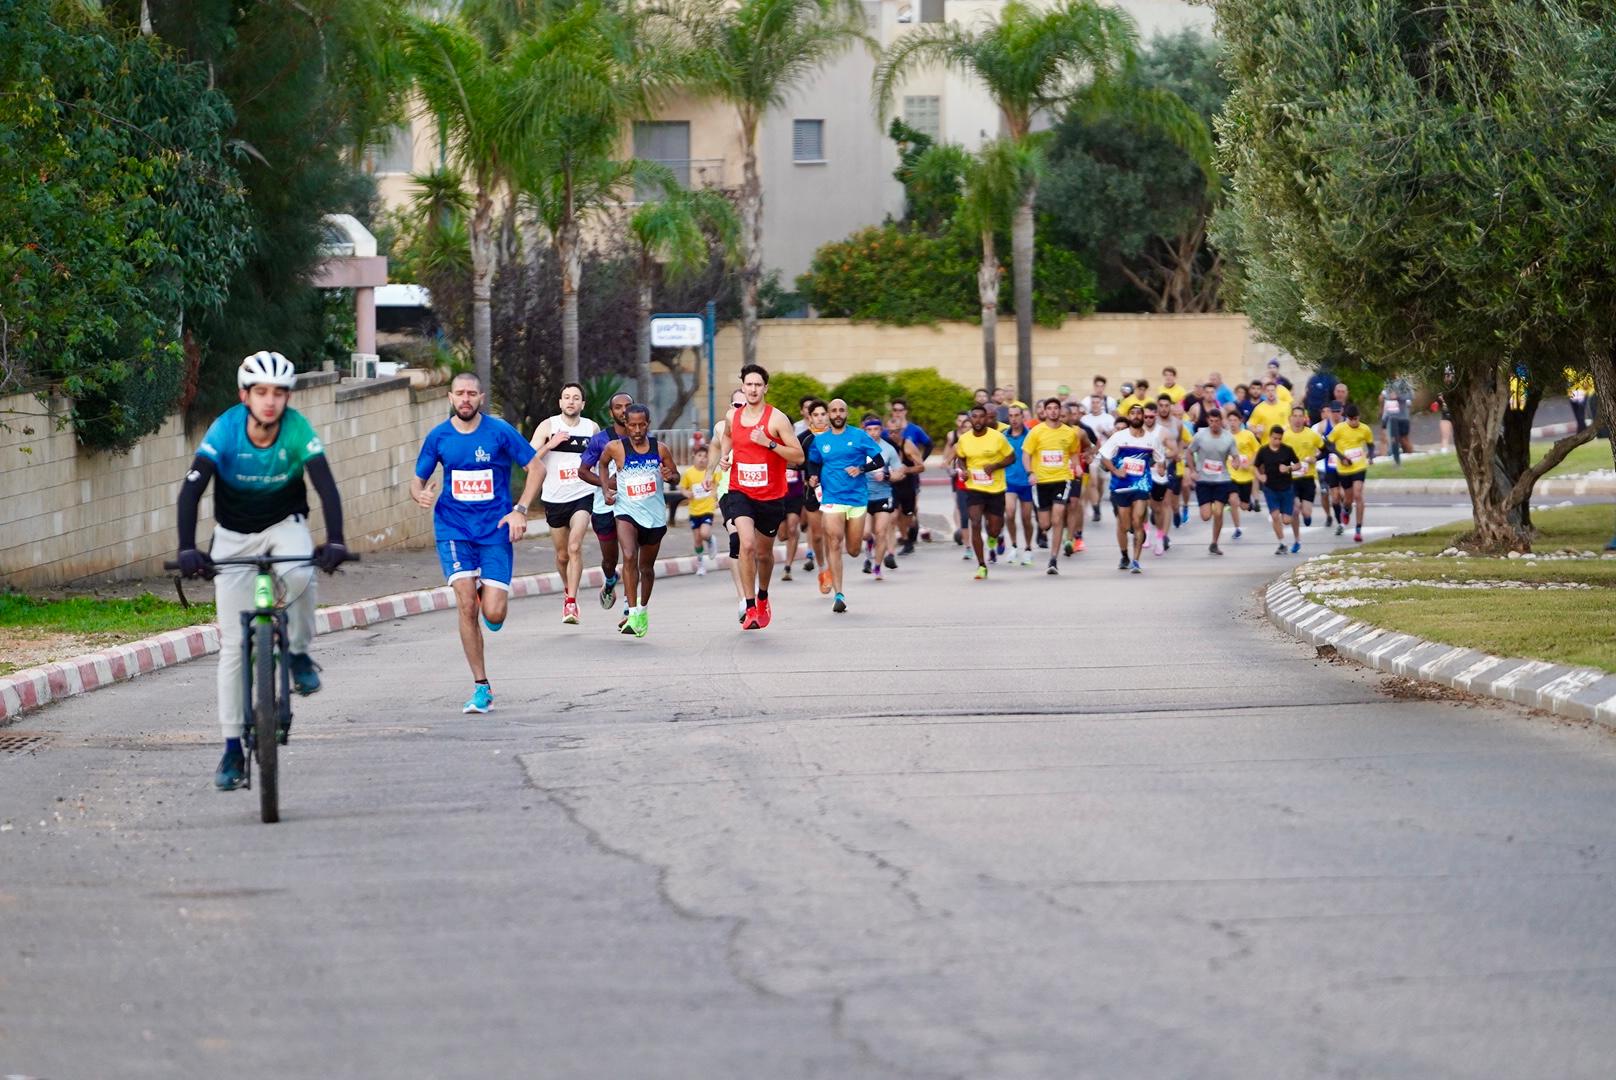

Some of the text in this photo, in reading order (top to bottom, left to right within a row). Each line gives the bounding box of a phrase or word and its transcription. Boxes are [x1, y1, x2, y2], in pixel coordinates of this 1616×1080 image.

[743, 471, 762, 480] 1293
[458, 480, 488, 491] 1444
[630, 483, 652, 495] 1086
